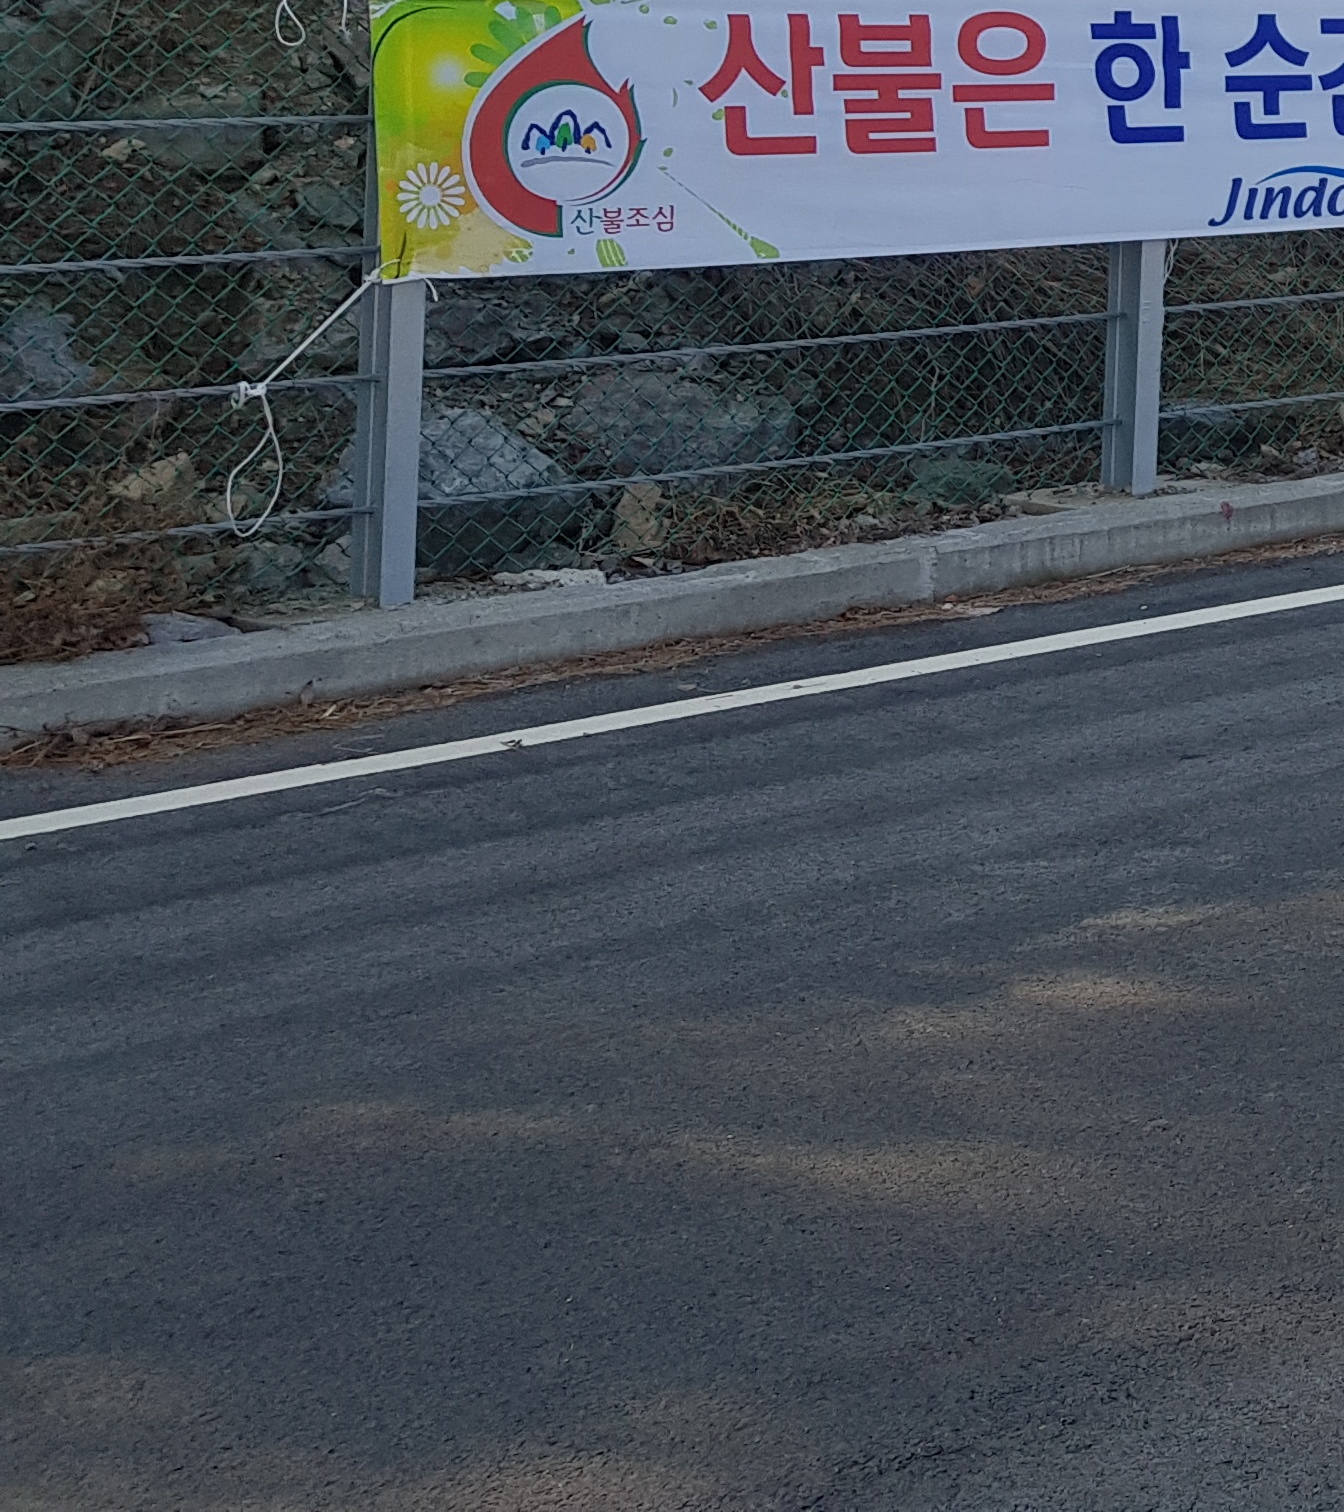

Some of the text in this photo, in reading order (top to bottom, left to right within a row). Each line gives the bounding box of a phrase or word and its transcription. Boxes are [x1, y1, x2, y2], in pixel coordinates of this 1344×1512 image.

[698, 11, 1055, 155] 산불은
[1091, 10, 1190, 144] 한
[570, 205, 675, 235] 산불조심
